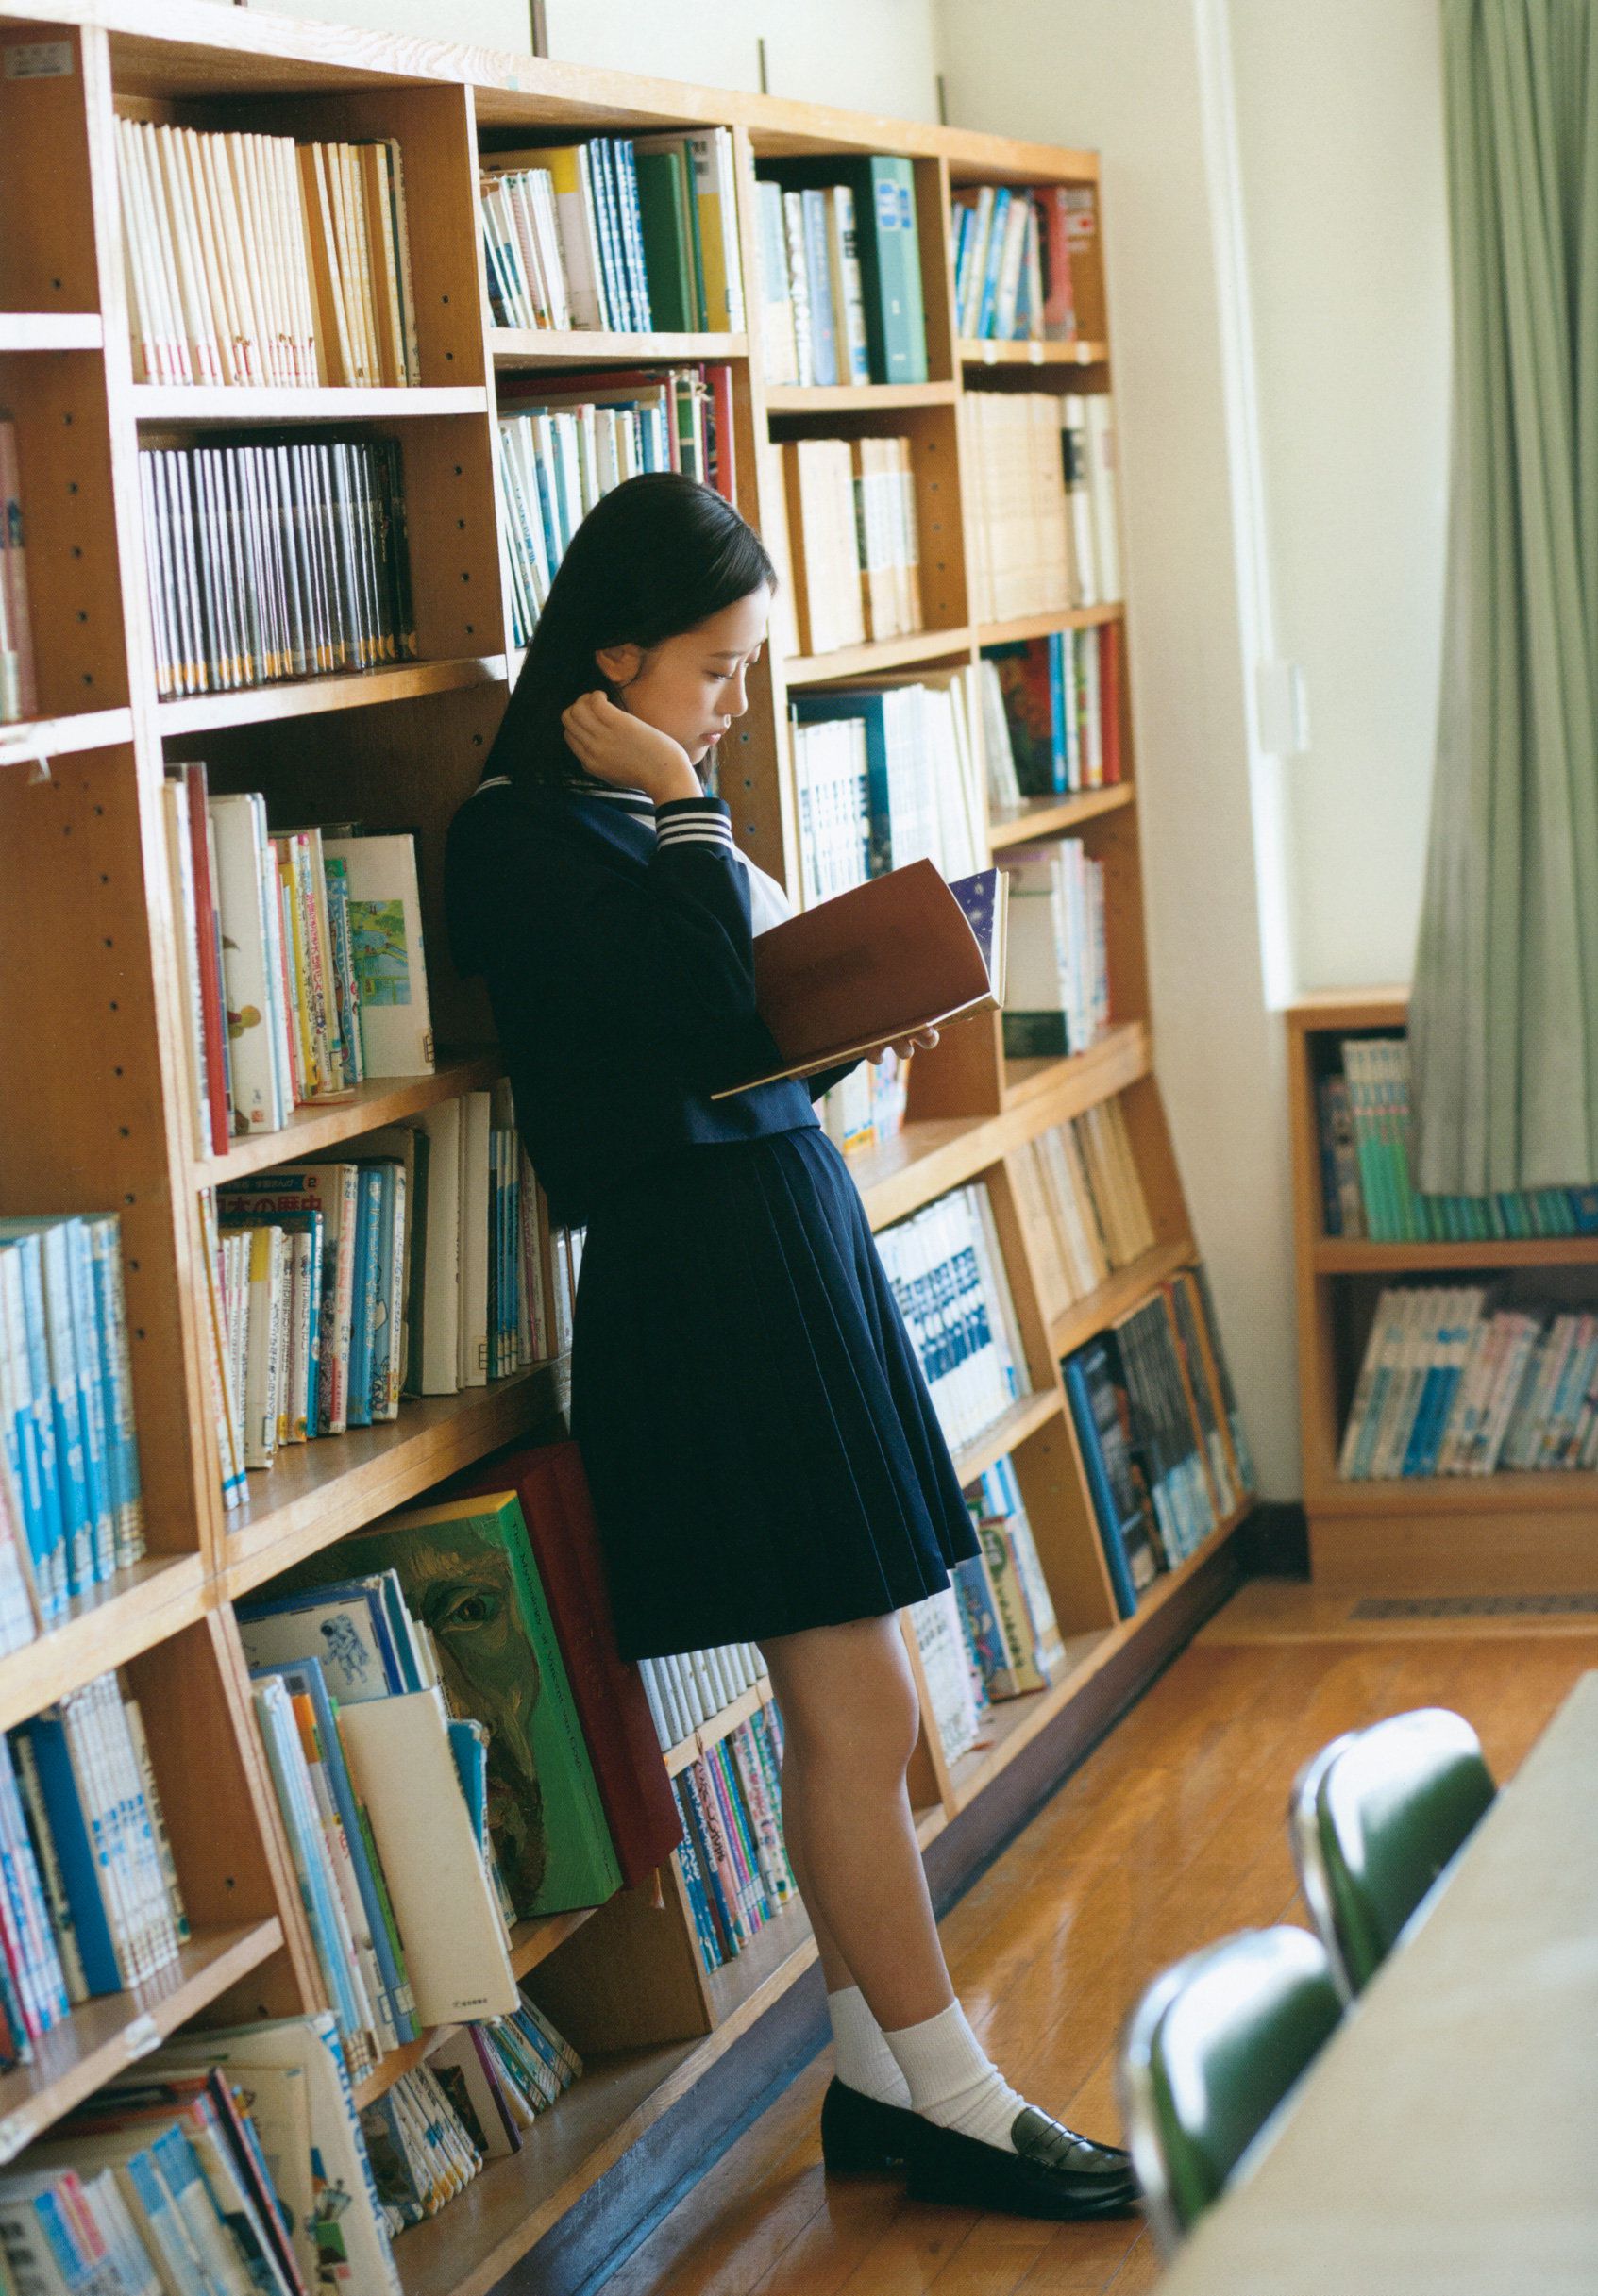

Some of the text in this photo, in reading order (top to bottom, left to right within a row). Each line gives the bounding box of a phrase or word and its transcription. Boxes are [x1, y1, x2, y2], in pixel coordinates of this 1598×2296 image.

[308, 1177, 316, 1187] 2
[520, 1553, 542, 1625] Mythology
[548, 1650, 564, 1702] Vincent
